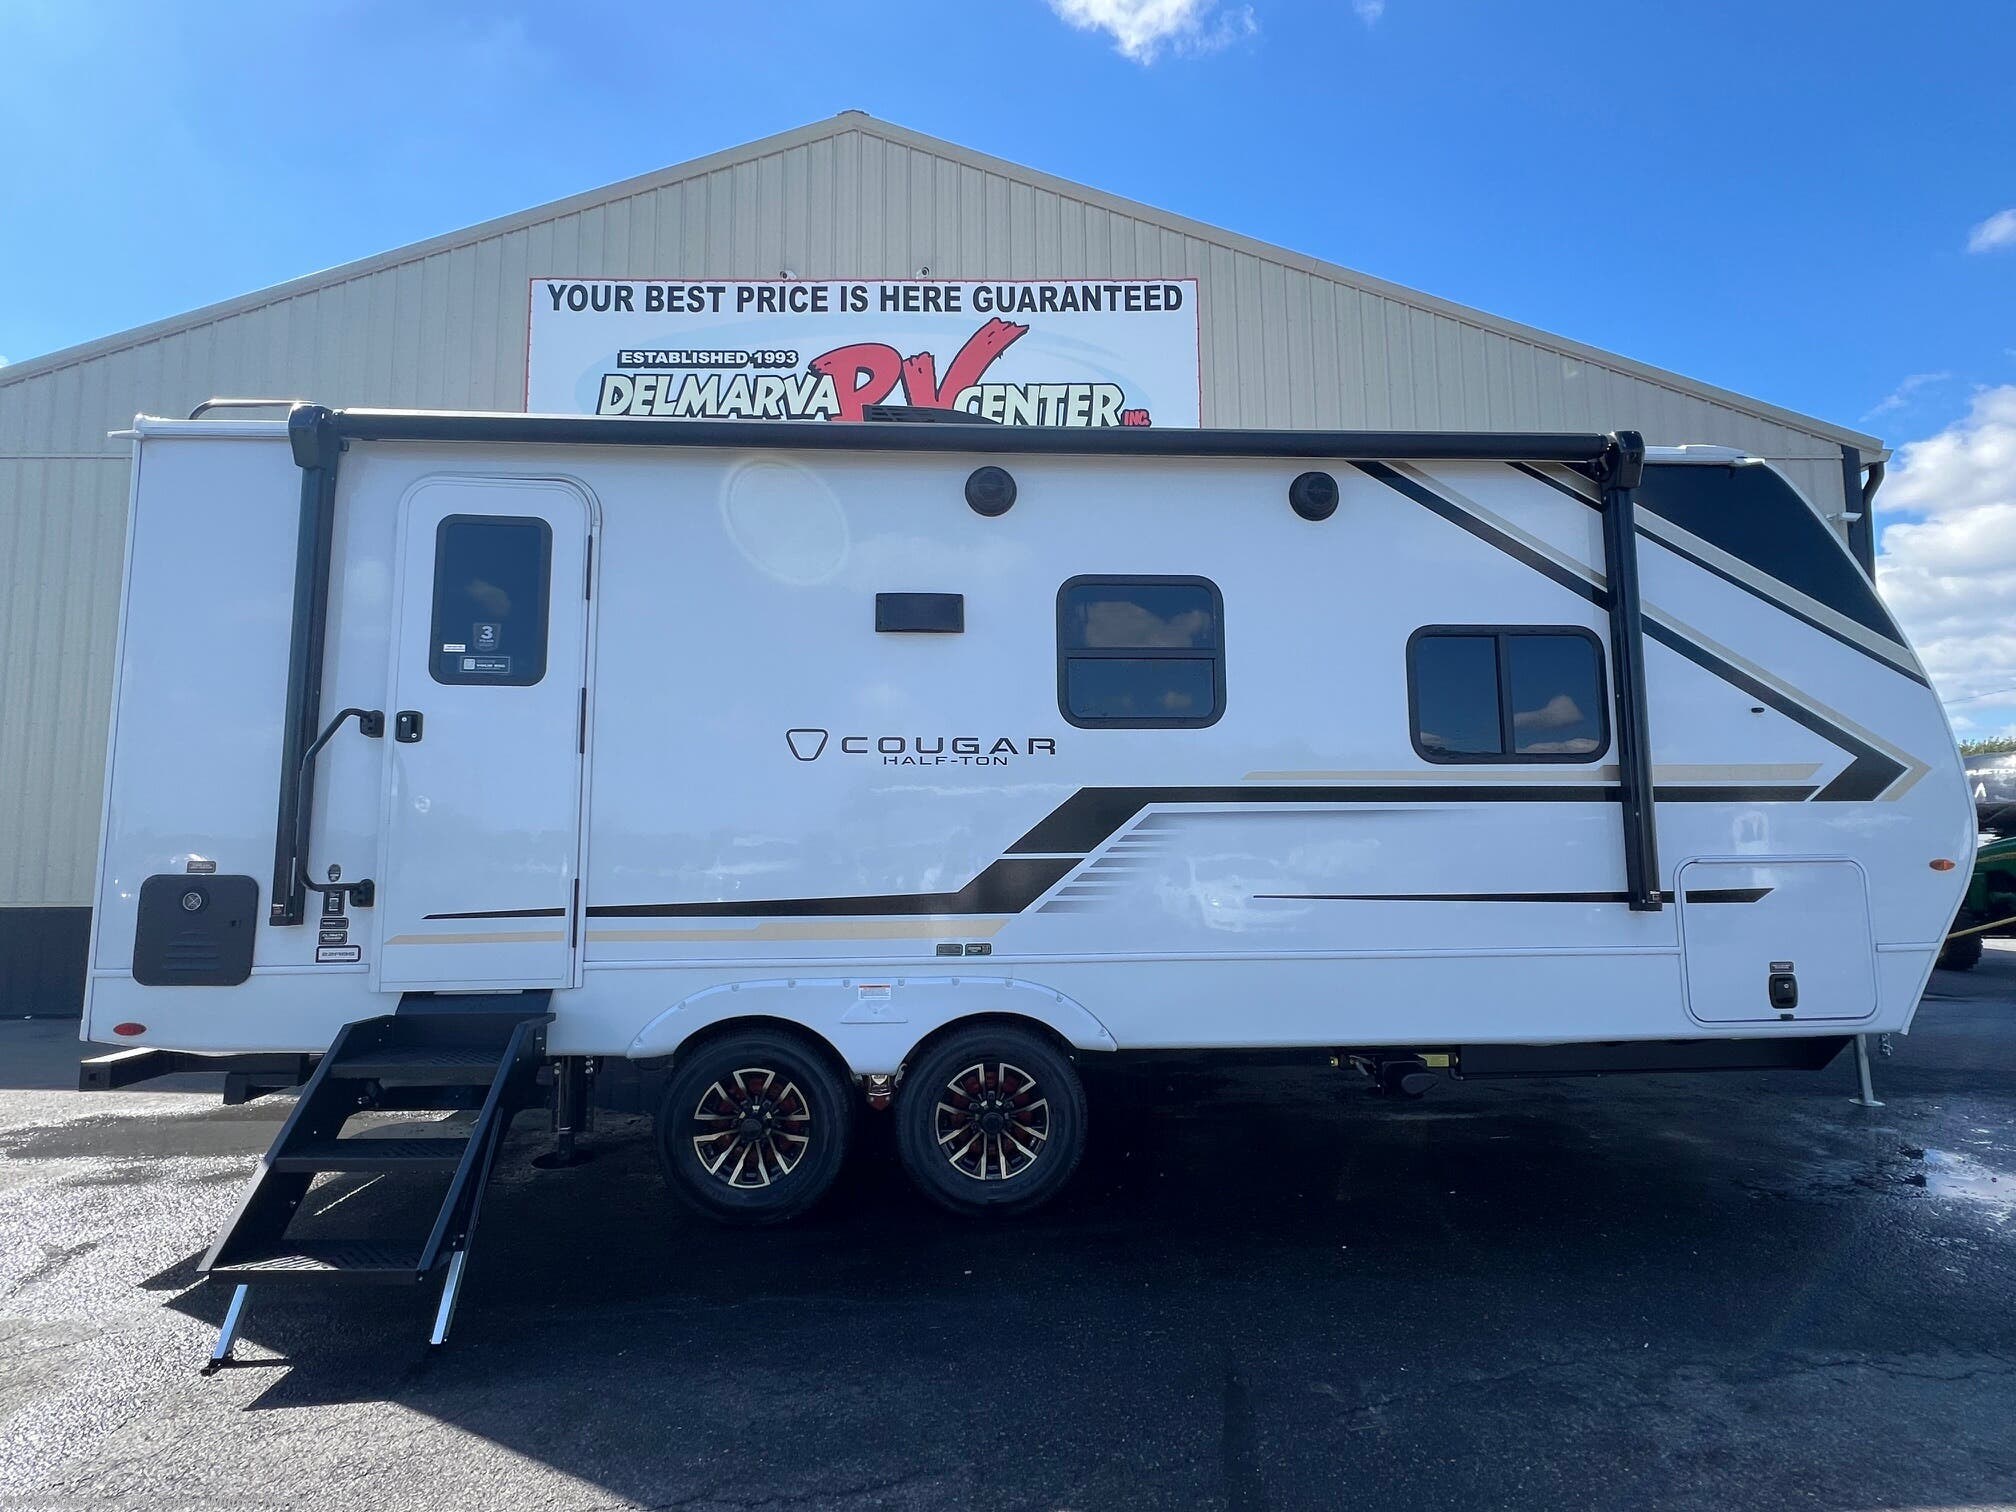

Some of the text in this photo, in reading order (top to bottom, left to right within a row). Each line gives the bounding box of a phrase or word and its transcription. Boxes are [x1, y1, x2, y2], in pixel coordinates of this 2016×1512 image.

[547, 284, 1183, 313] YOUR BEST PRICE IS HERE GUARANTEED
[619, 350, 799, 367] ESTABLISHED 1993
[596, 373, 842, 418] DELMARVA
[808, 317, 1030, 423] RV
[952, 382, 1125, 428] CENTER
[480, 625, 494, 639] 3
[841, 736, 1056, 755] COUGAR
[883, 756, 1008, 766] HALF-TON
